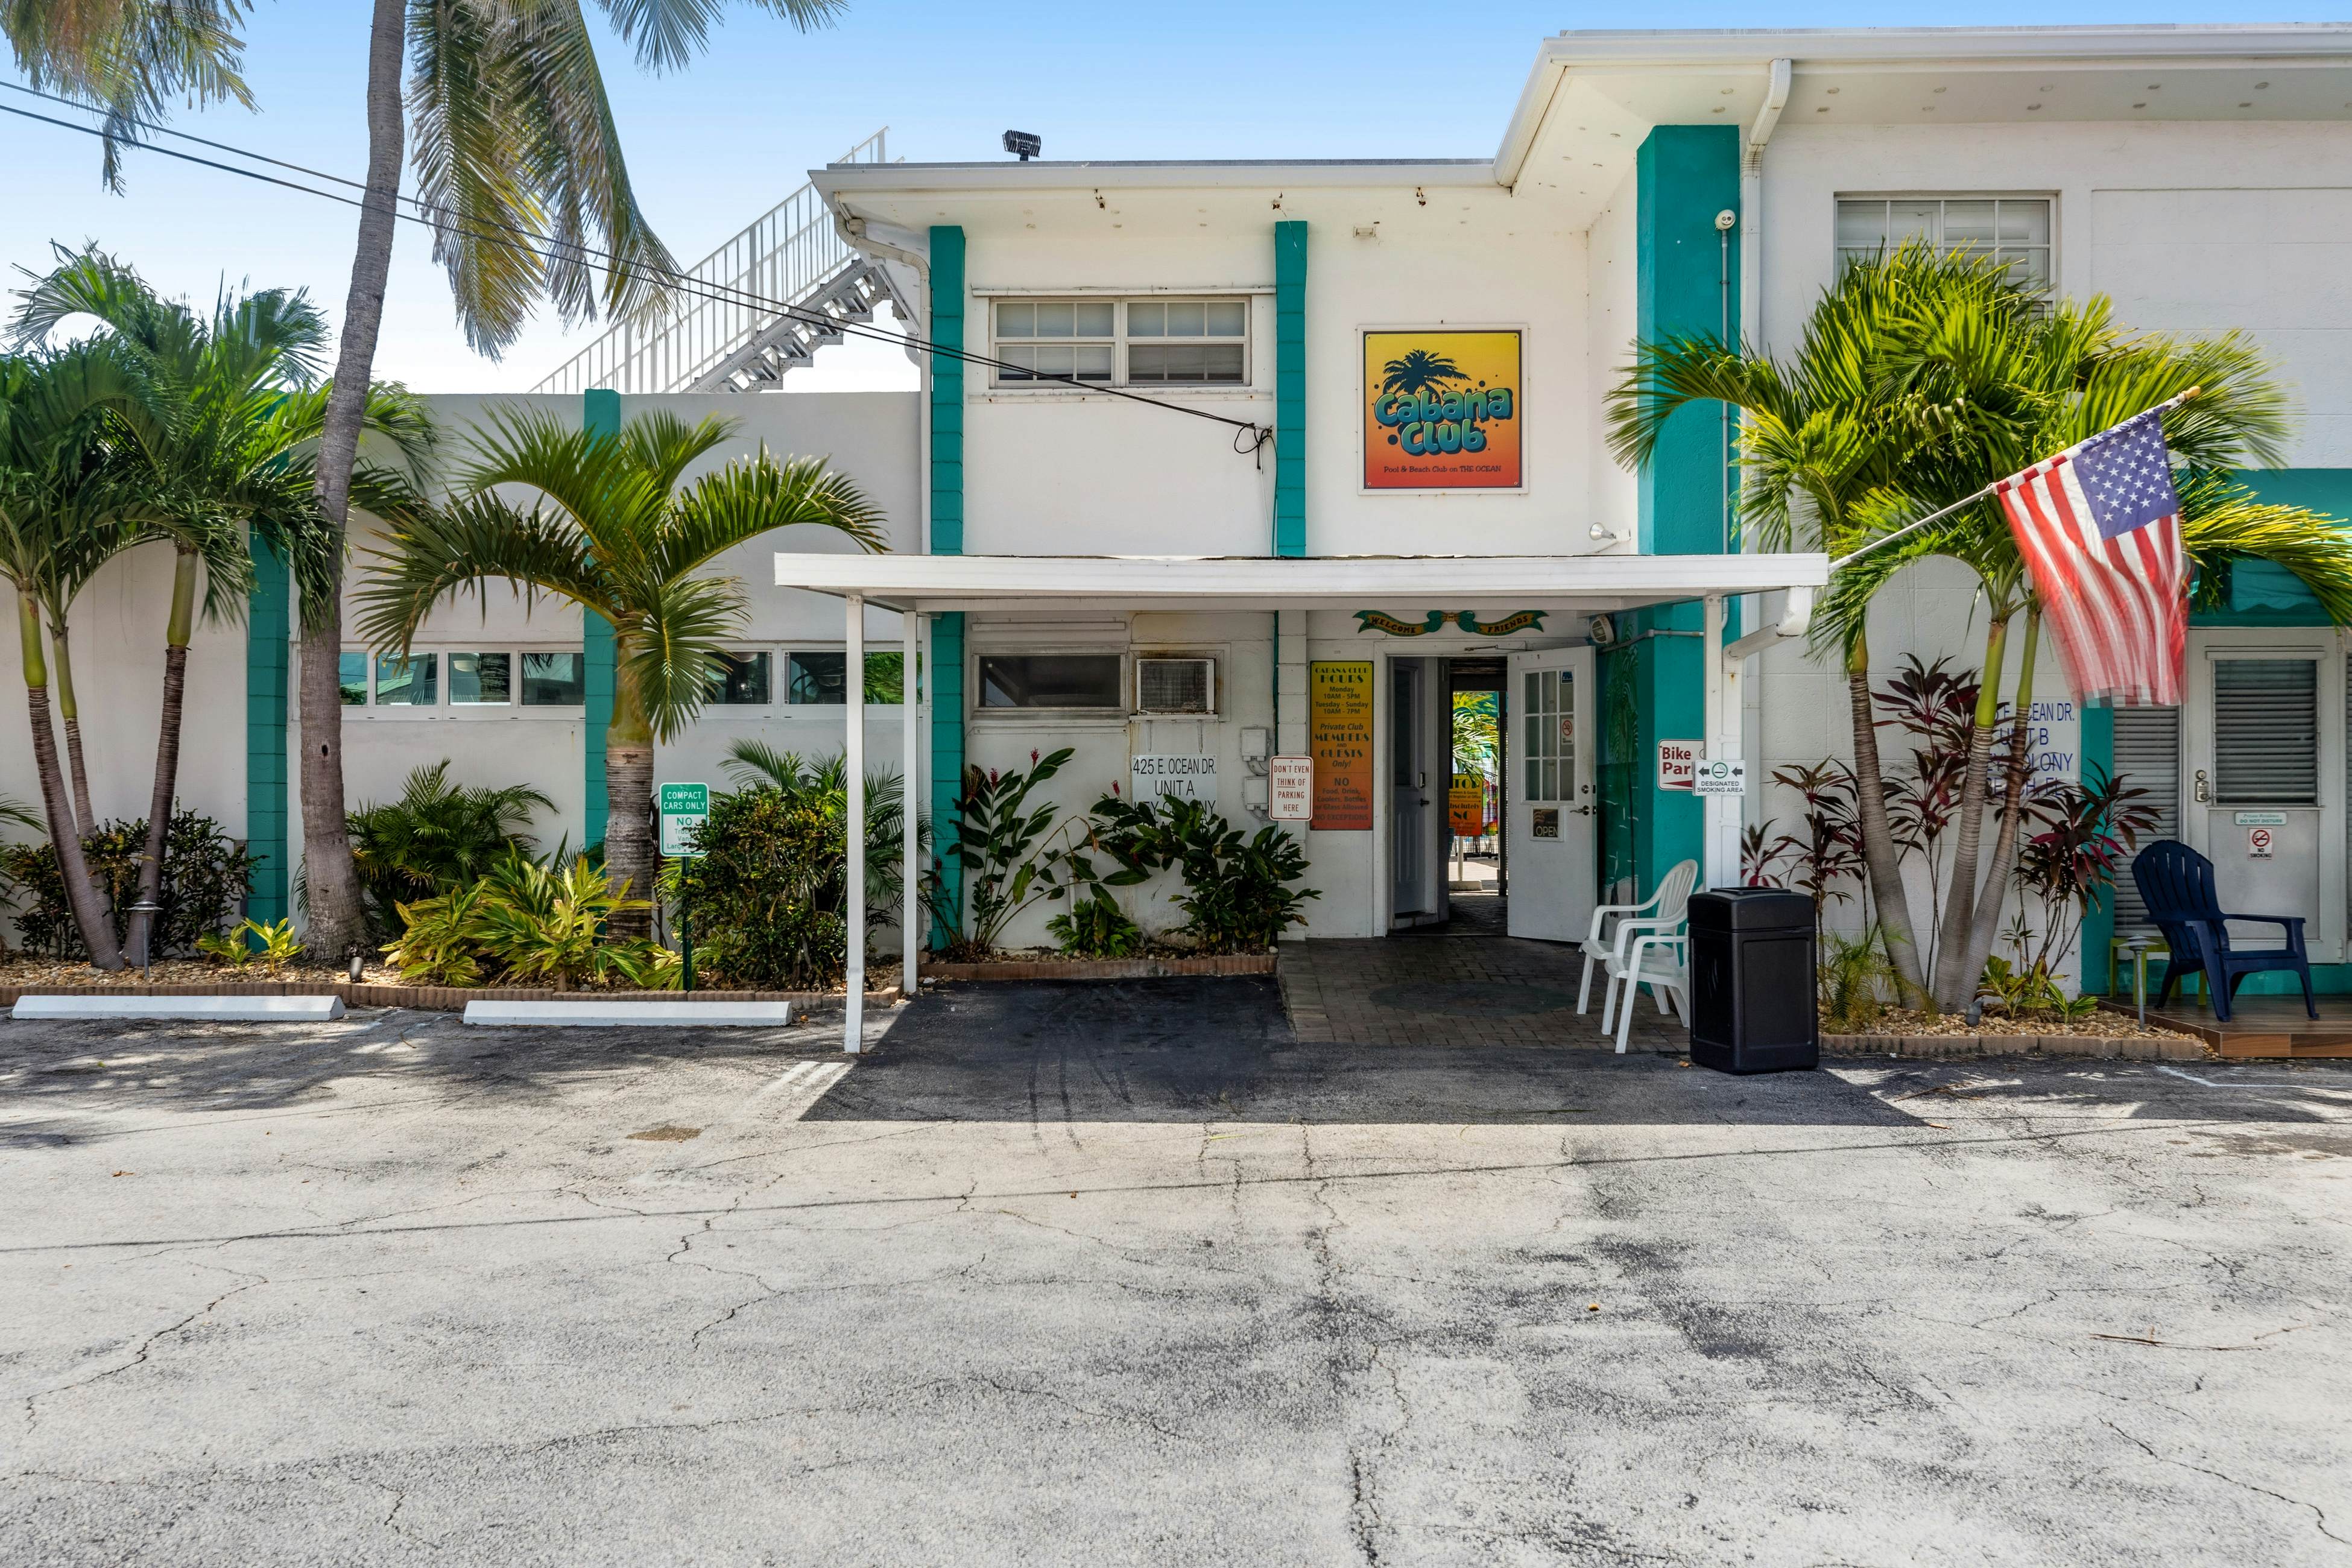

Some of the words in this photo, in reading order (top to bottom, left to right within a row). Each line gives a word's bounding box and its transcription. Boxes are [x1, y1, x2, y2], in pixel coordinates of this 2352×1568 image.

[1375, 388, 1511, 425] Cabana
[1371, 617, 1416, 633] WELCOME
[1488, 616, 1528, 633] FRIENDS
[1321, 675, 1364, 683] HOURS
[2057, 703, 2075, 721] DR.
[1315, 733, 1370, 742] MEMBERS
[2040, 728, 2049, 745] B
[1662, 747, 1692, 760] Bike
[1133, 759, 1154, 774] 425
[1158, 759, 1166, 774] E.
[1169, 758, 1200, 774] OCEAN
[1202, 758, 1216, 774] DR.
[1332, 760, 1351, 769] Only!
[1334, 777, 1350, 786] NO
[1155, 780, 1184, 796] UNIT
[1186, 780, 1195, 796] A
[663, 801, 683, 810] CARS
[685, 801, 706, 810] ONLY
[677, 817, 692, 826] NO
[1535, 826, 1558, 836] OPEN
